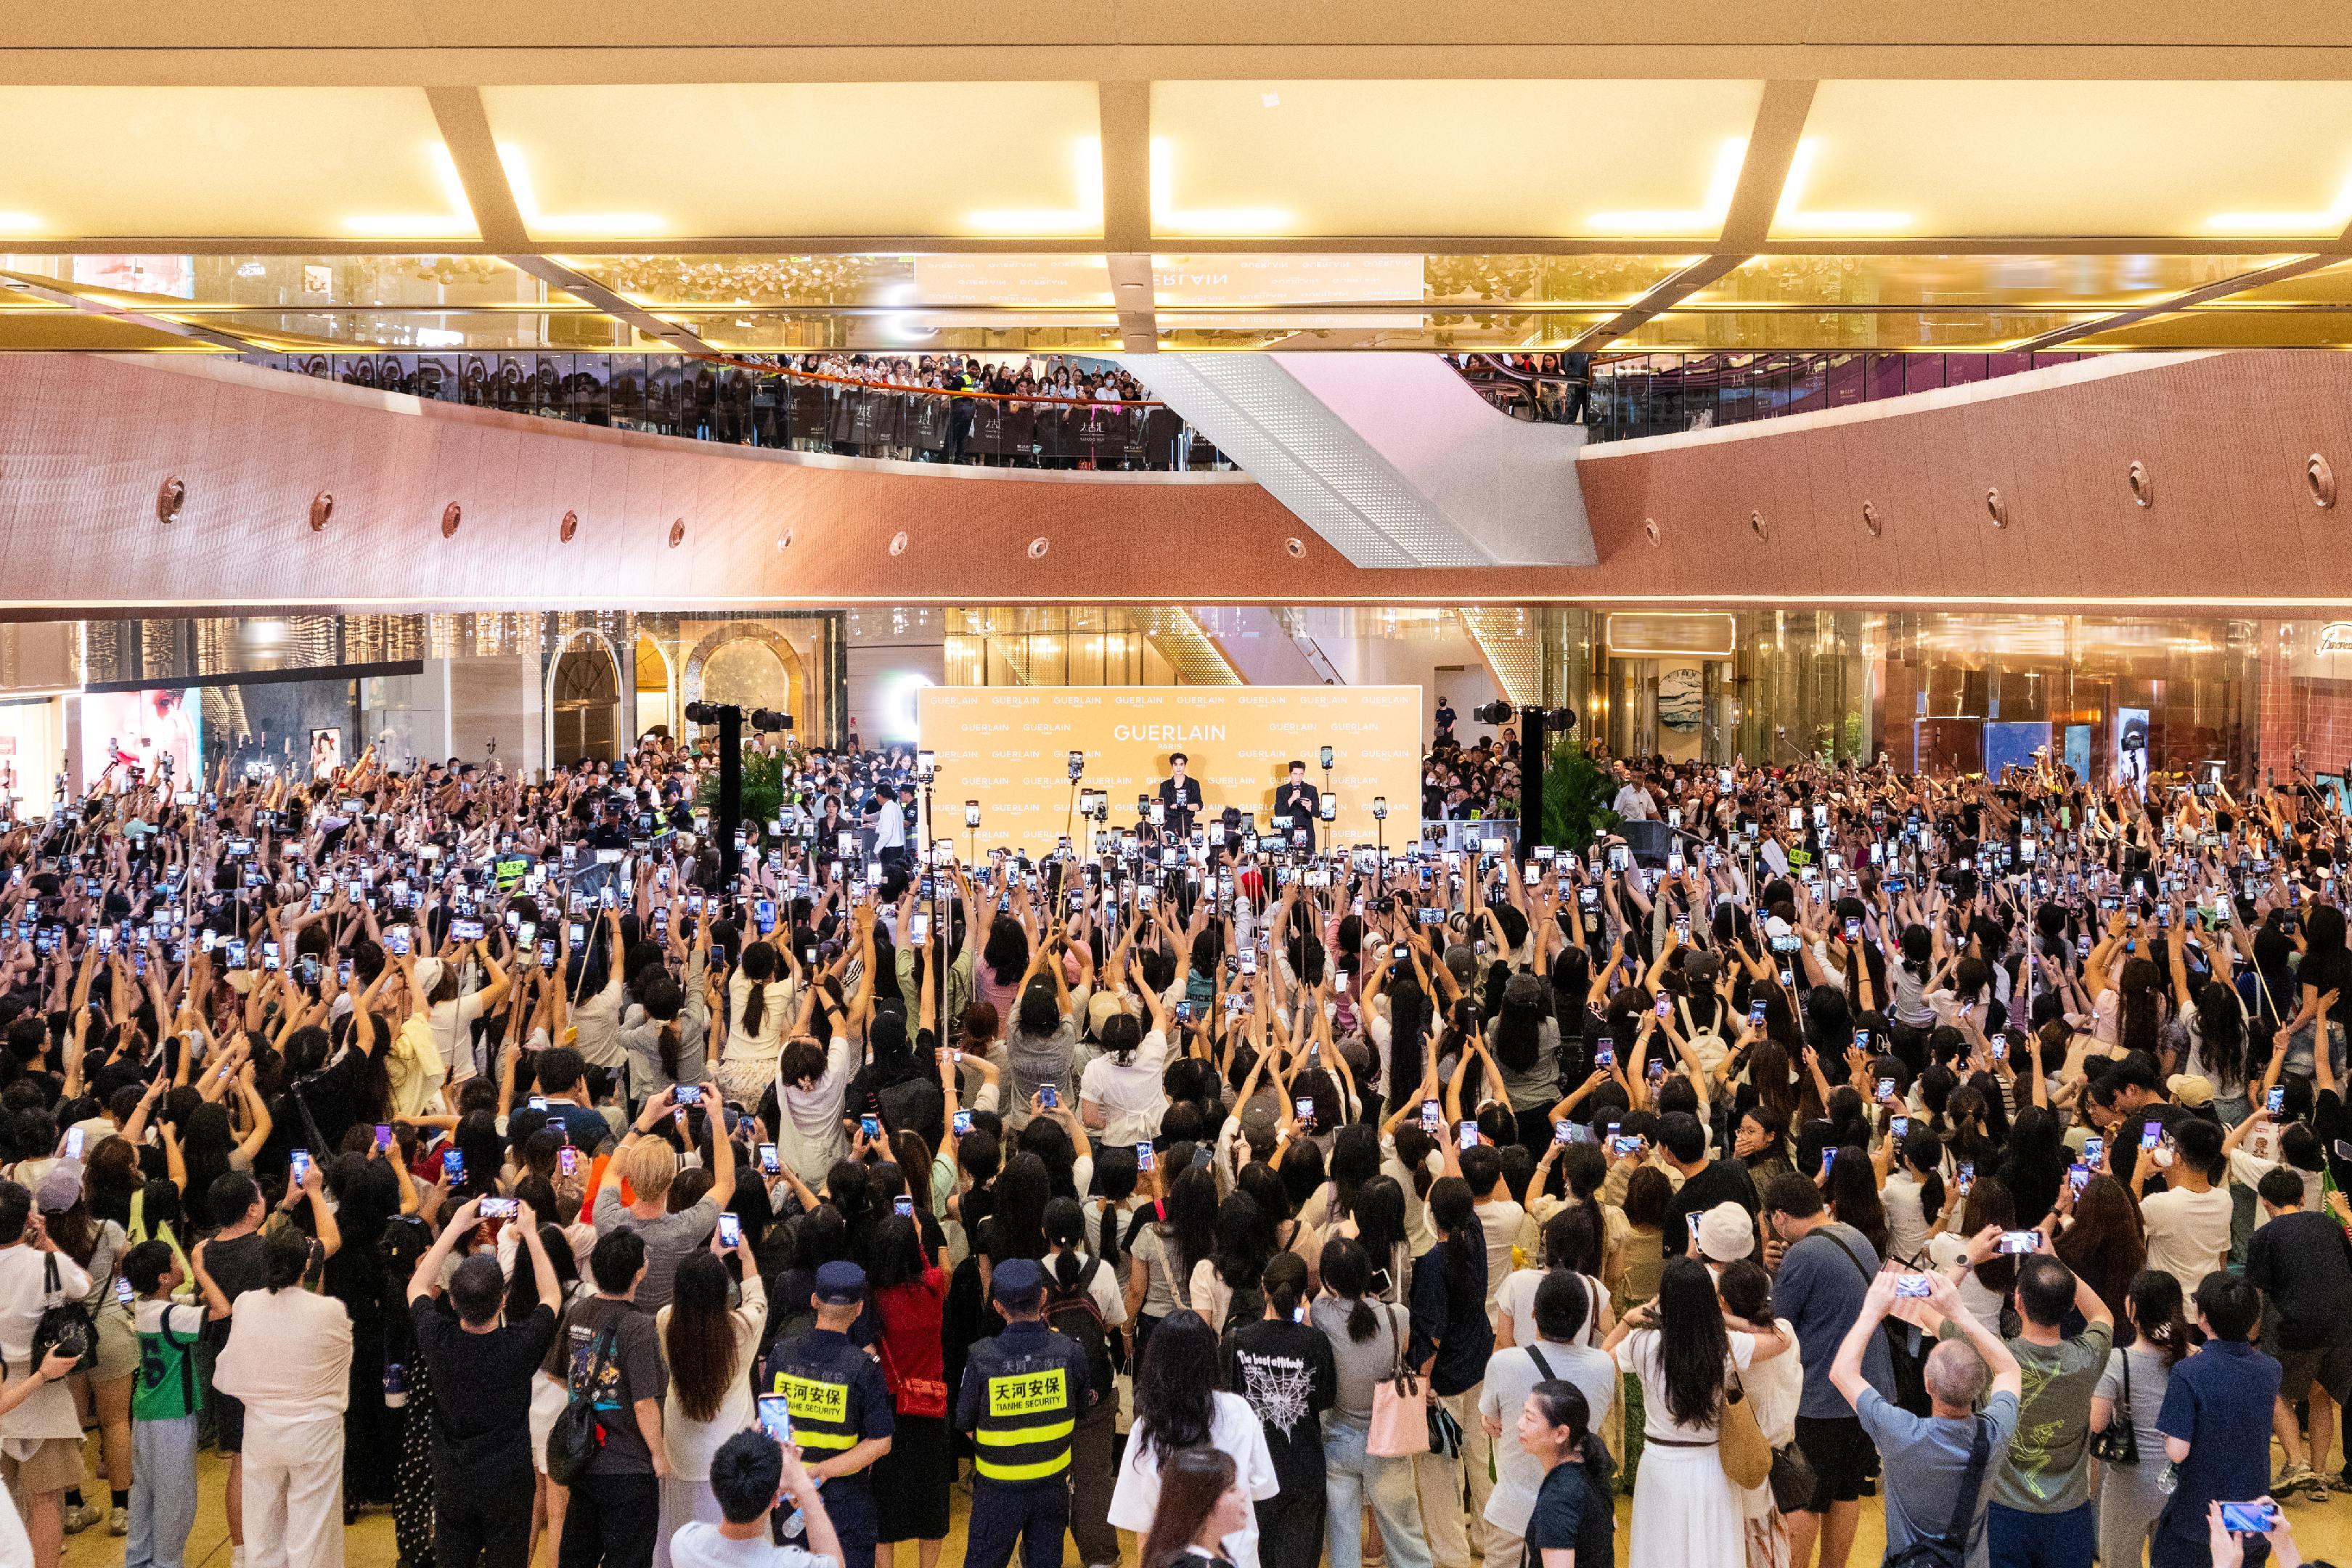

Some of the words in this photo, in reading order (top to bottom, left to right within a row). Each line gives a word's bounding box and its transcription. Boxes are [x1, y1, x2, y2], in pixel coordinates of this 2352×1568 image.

[1079, 422, 1105, 433] 太古汇
[930, 696, 979, 705] GUERLAIN
[992, 696, 1040, 705] GUERLAIN
[961, 723, 1010, 732] GUERLAIN
[1023, 723, 1071, 732] GUERLAIN
[1114, 724, 1226, 741] GUERLAIN
[780, 1381, 841, 1405] 天河安保
[995, 1377, 1060, 1401] 天河安保
[788, 1400, 802, 1412] NHE
[805, 1404, 841, 1416] SECURITY
[996, 1401, 1023, 1411] TIANHE
[1025, 1395, 1061, 1408] SECURITY
